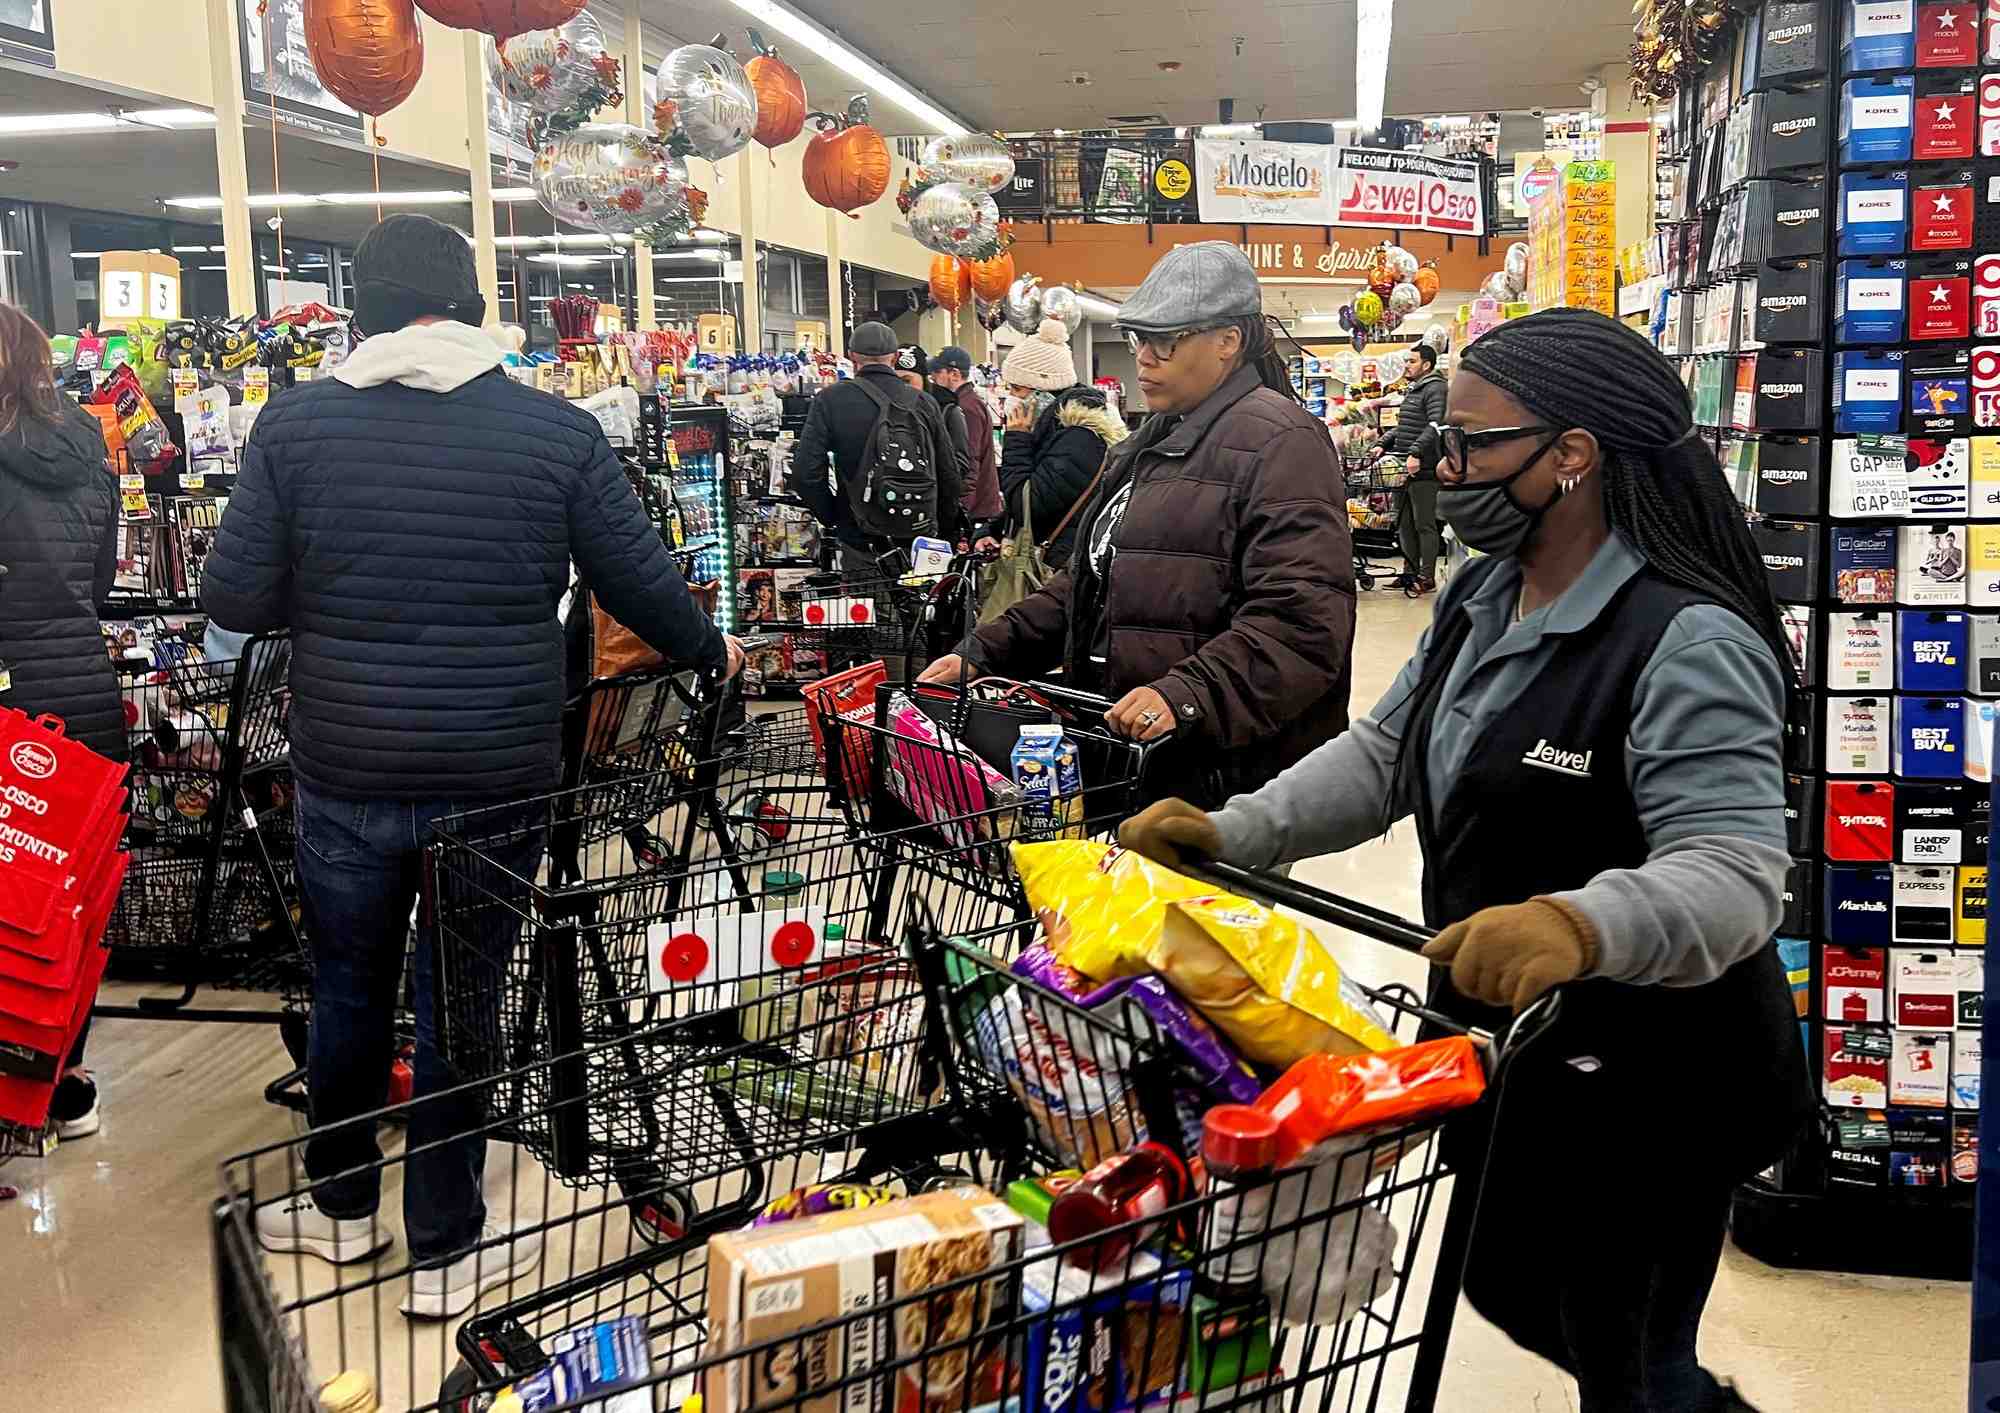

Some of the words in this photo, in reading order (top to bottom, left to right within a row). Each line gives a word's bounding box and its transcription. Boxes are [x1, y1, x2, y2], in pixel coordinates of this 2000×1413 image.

[1767, 22, 1812, 41] amazon
[1772, 116, 1816, 133] amazon
[1342, 153, 1392, 168] WELCOME
[1229, 153, 1308, 188] Modelo
[1013, 176, 1035, 191] Lite
[1342, 173, 1424, 213] Jewel
[1777, 207, 1820, 222] amazon
[1293, 244, 1304, 269] &
[118, 280, 130, 308] 3
[160, 283, 167, 311] 3
[1760, 295, 1807, 308] amazon
[708, 330, 717, 345] 6
[803, 334, 811, 348] 7
[1760, 383, 1804, 394] amazon
[1850, 456, 1882, 473] GAP
[1761, 469, 1807, 481] amazon
[1856, 495, 1889, 511] GAP
[1913, 641, 1951, 653] BEST
[1915, 652, 1947, 663] BUY
[1911, 728, 1950, 739] BEST
[1914, 739, 1946, 751] BUY
[1525, 739, 1592, 771] Jewel
[0, 822, 69, 865] MUNITY
[1914, 844, 1937, 853] END
[1898, 882, 1946, 891] EXPRESS
[1838, 900, 1888, 913] Marshalls
[1827, 966, 1882, 981] JCPenney
[1831, 1150, 1881, 1165] REGAL
[852, 1295, 869, 1353] FIBR
[851, 1360, 866, 1407] HIH
